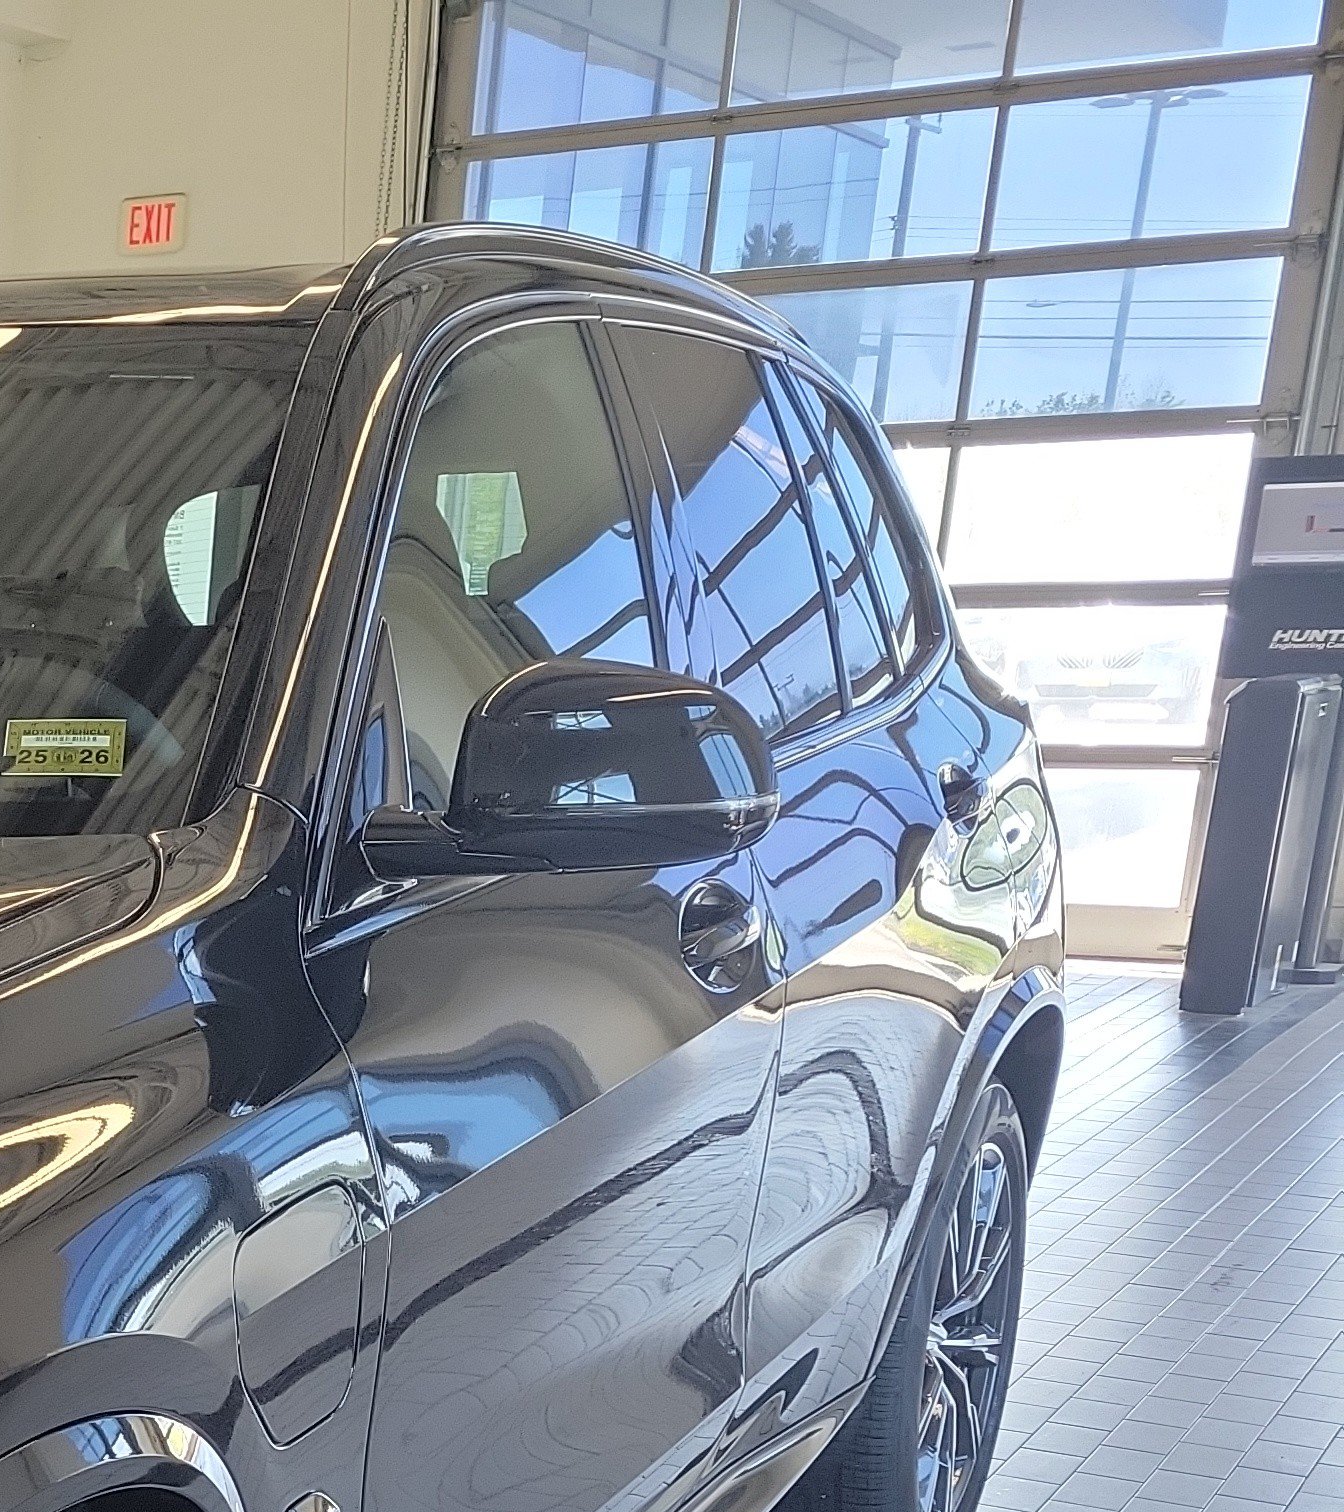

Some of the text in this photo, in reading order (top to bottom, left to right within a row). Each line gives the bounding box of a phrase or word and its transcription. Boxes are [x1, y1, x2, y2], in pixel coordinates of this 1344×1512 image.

[129, 202, 176, 246] EXIT
[1272, 629, 1344, 642] HUNT
[17, 749, 49, 764] 25
[78, 749, 110, 764] 26
